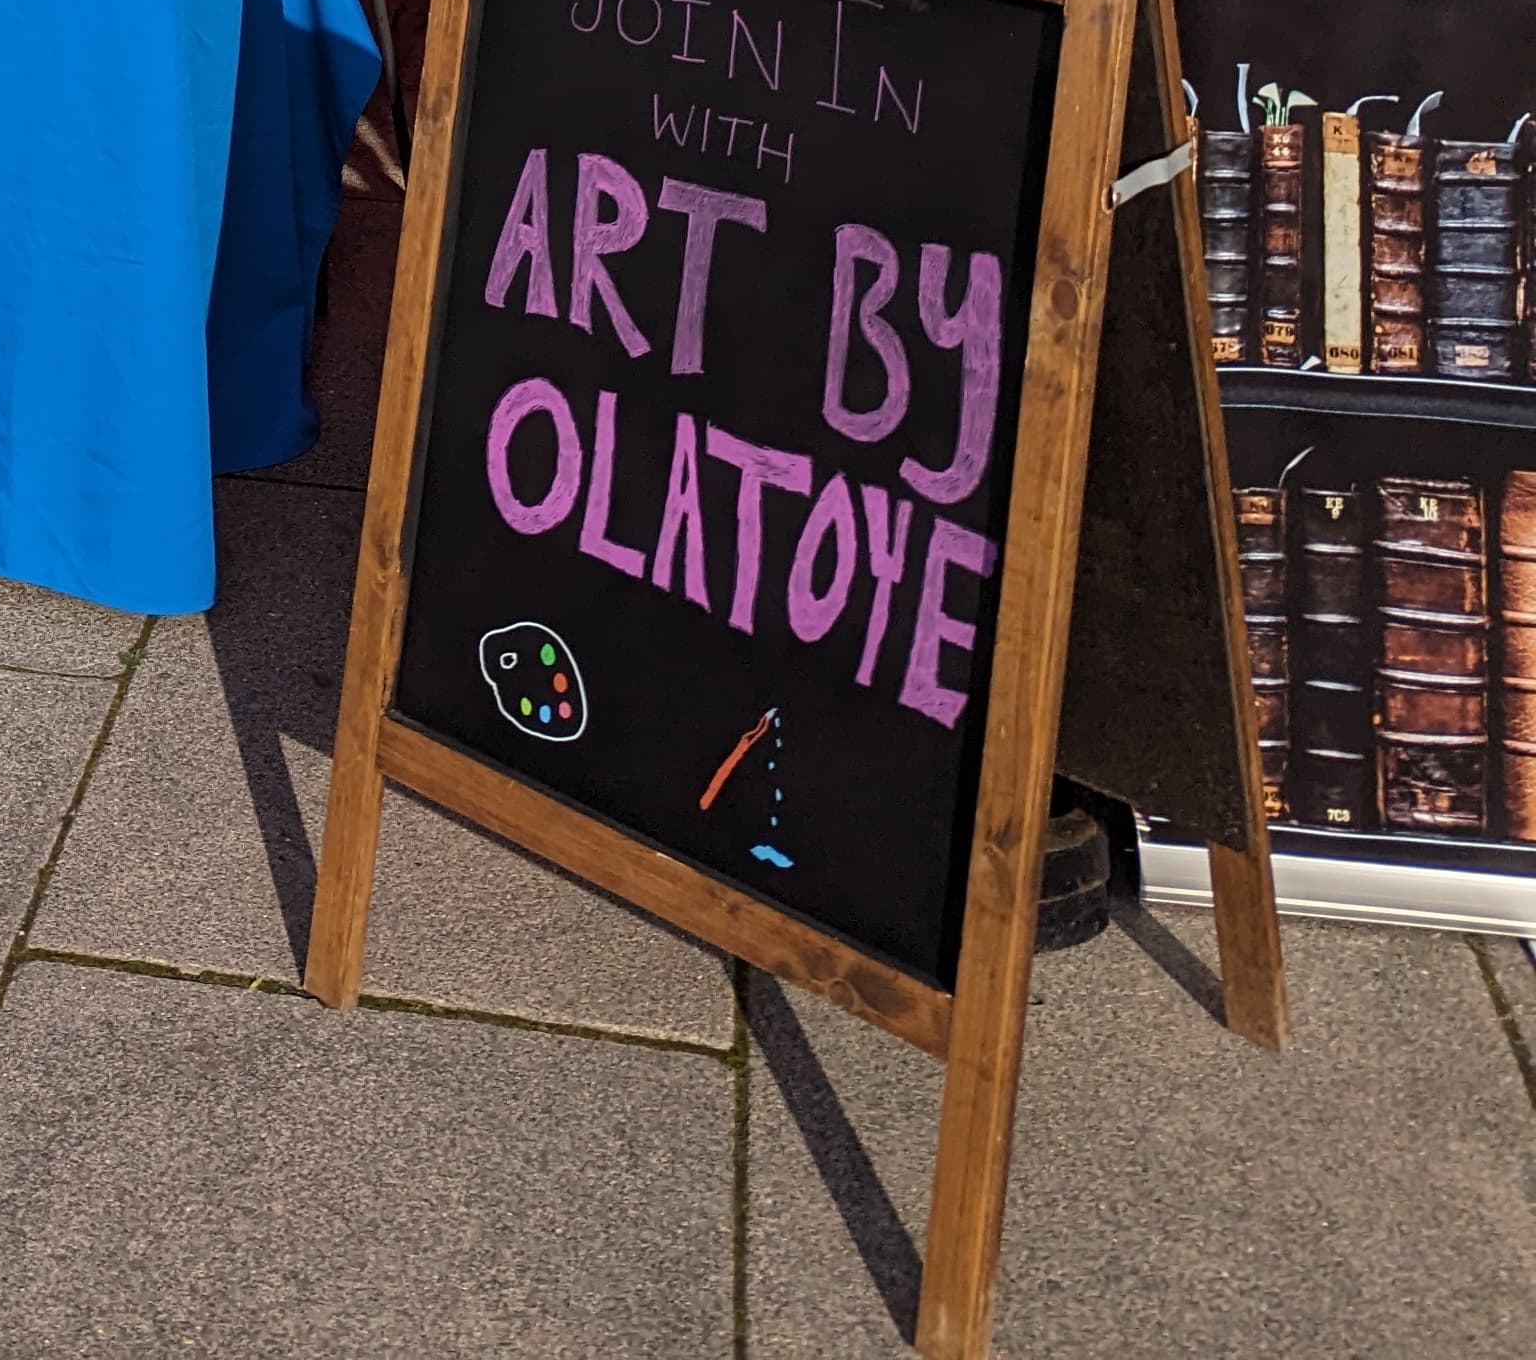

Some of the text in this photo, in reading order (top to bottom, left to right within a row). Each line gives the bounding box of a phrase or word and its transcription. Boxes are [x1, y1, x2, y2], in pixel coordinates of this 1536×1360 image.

[651, 92, 795, 184] WITH
[484, 147, 1003, 505] ART BY
[1329, 347, 1359, 360] 680
[486, 376, 1000, 730] OLATOYE
